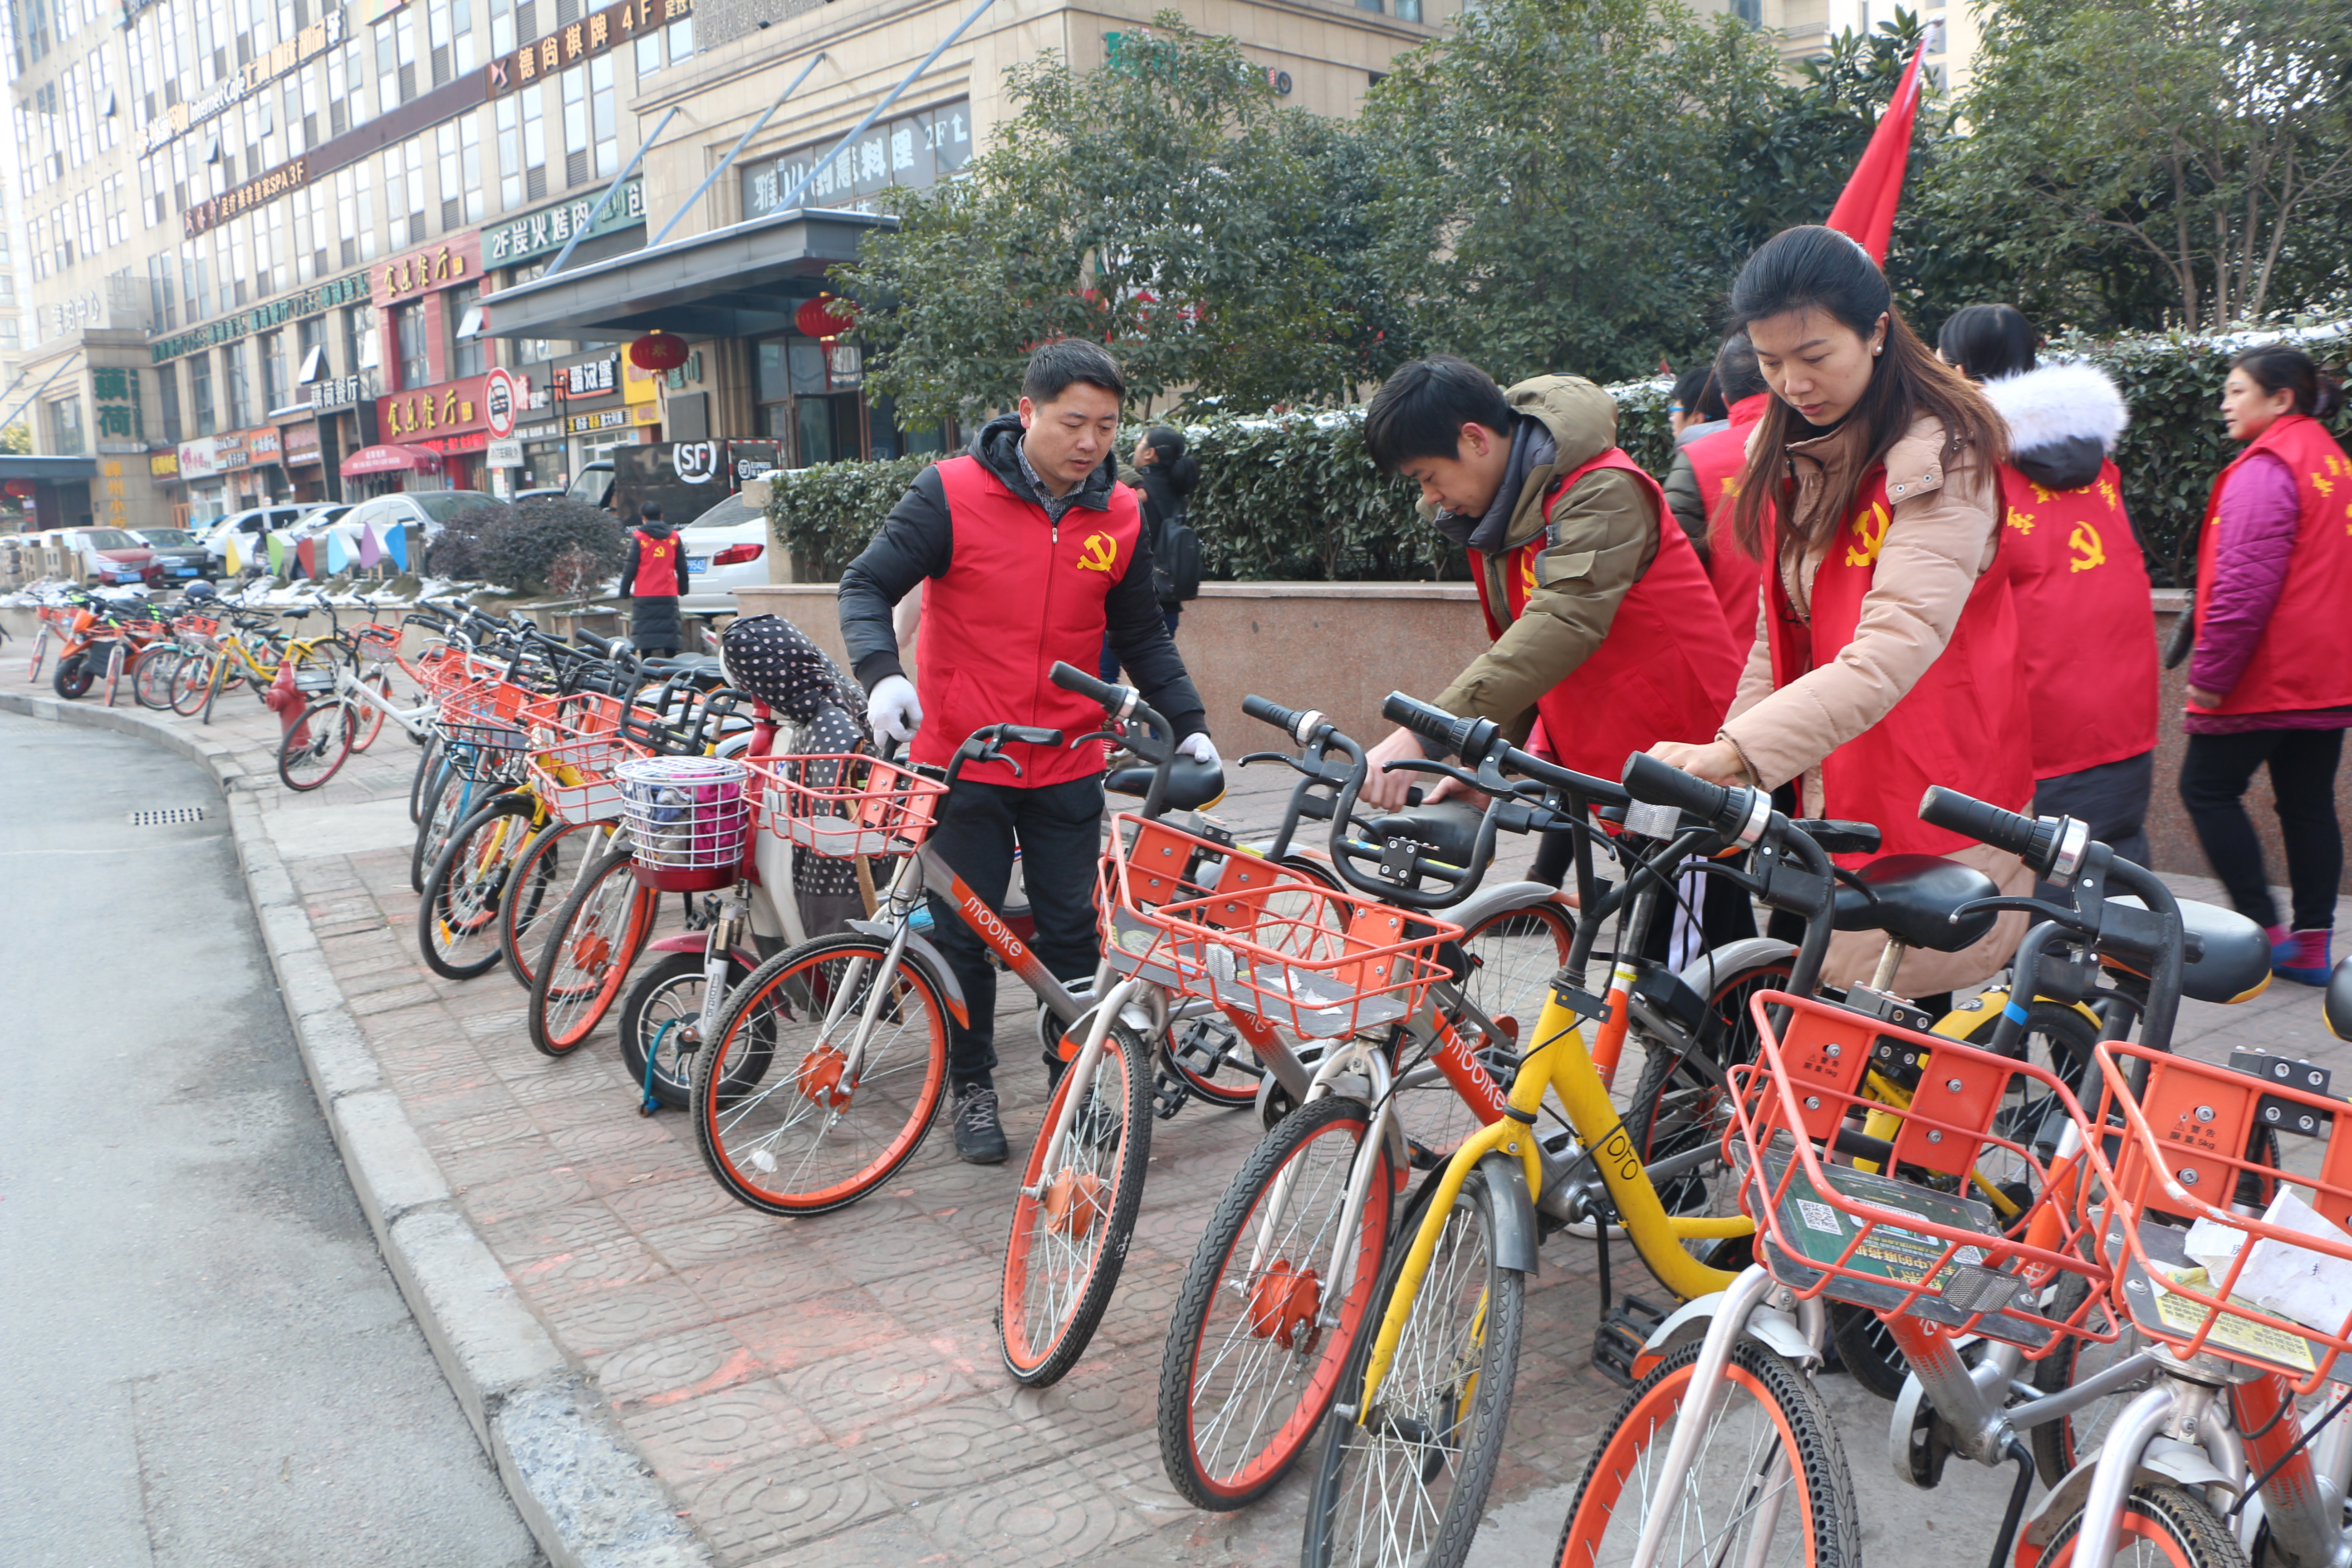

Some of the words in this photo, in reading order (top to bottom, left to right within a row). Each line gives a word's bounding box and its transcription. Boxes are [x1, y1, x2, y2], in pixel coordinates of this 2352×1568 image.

[519, 13, 608, 80] 德尚棋牌
[622, 1, 652, 30] 4F
[665, 0, 693, 19] 足疗
[924, 120, 947, 151] 2F
[289, 161, 304, 185] 3F
[93, 368, 131, 437] 藕荷
[310, 374, 358, 409] 藕荷餐厅
